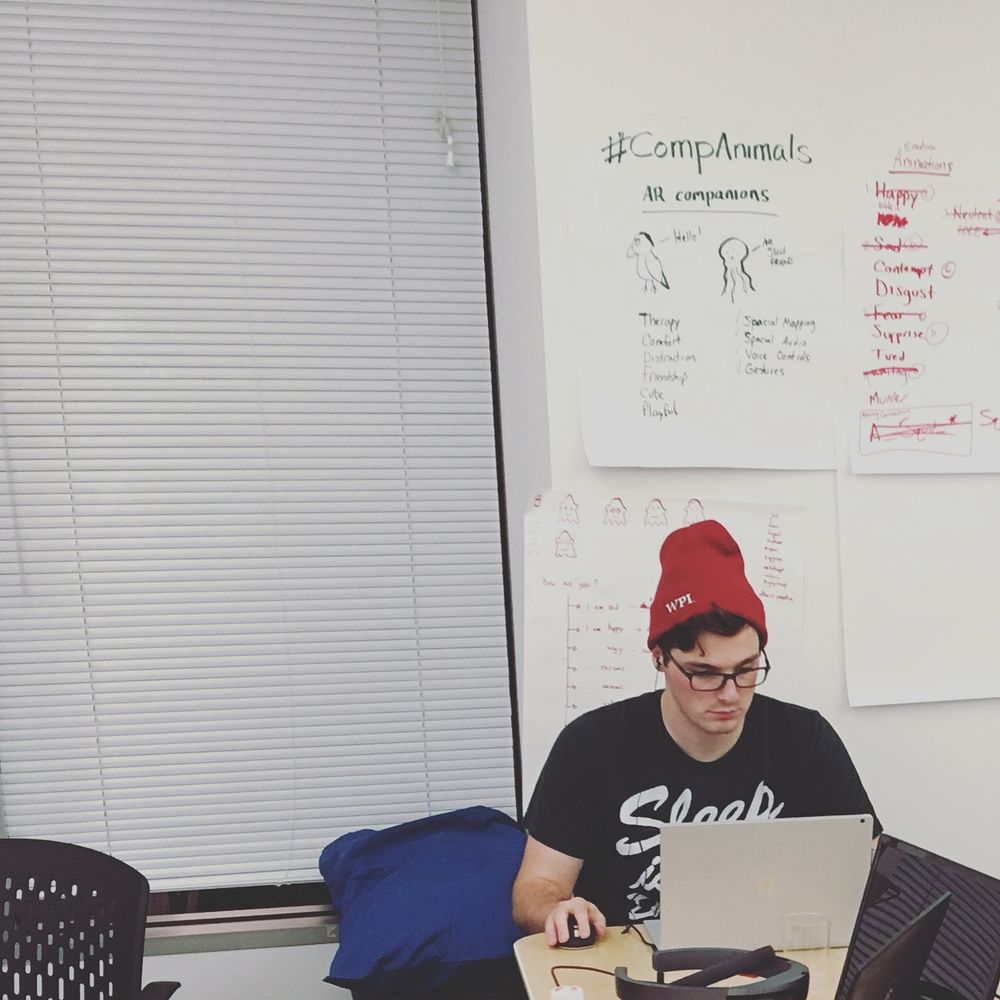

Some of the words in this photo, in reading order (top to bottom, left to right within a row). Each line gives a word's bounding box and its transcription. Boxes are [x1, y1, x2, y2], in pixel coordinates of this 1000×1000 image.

[601, 131, 812, 175] #CompAnimals
[642, 185, 665, 202] AR
[675, 187, 770, 207] companions
[875, 181, 918, 209] Happy
[873, 260, 934, 278] Contempt
[875, 278, 935, 305] Disgust
[638, 312, 681, 332] Therapy
[642, 333, 681, 347] Comfort
[872, 323, 924, 344] Surprise
[643, 351, 697, 363] Distraction
[871, 348, 905, 362] Tired
[643, 366, 688, 385] Friendship
[640, 387, 664, 400] Cute
[642, 401, 678, 421] Playful
[665, 593, 693, 614] WPI
